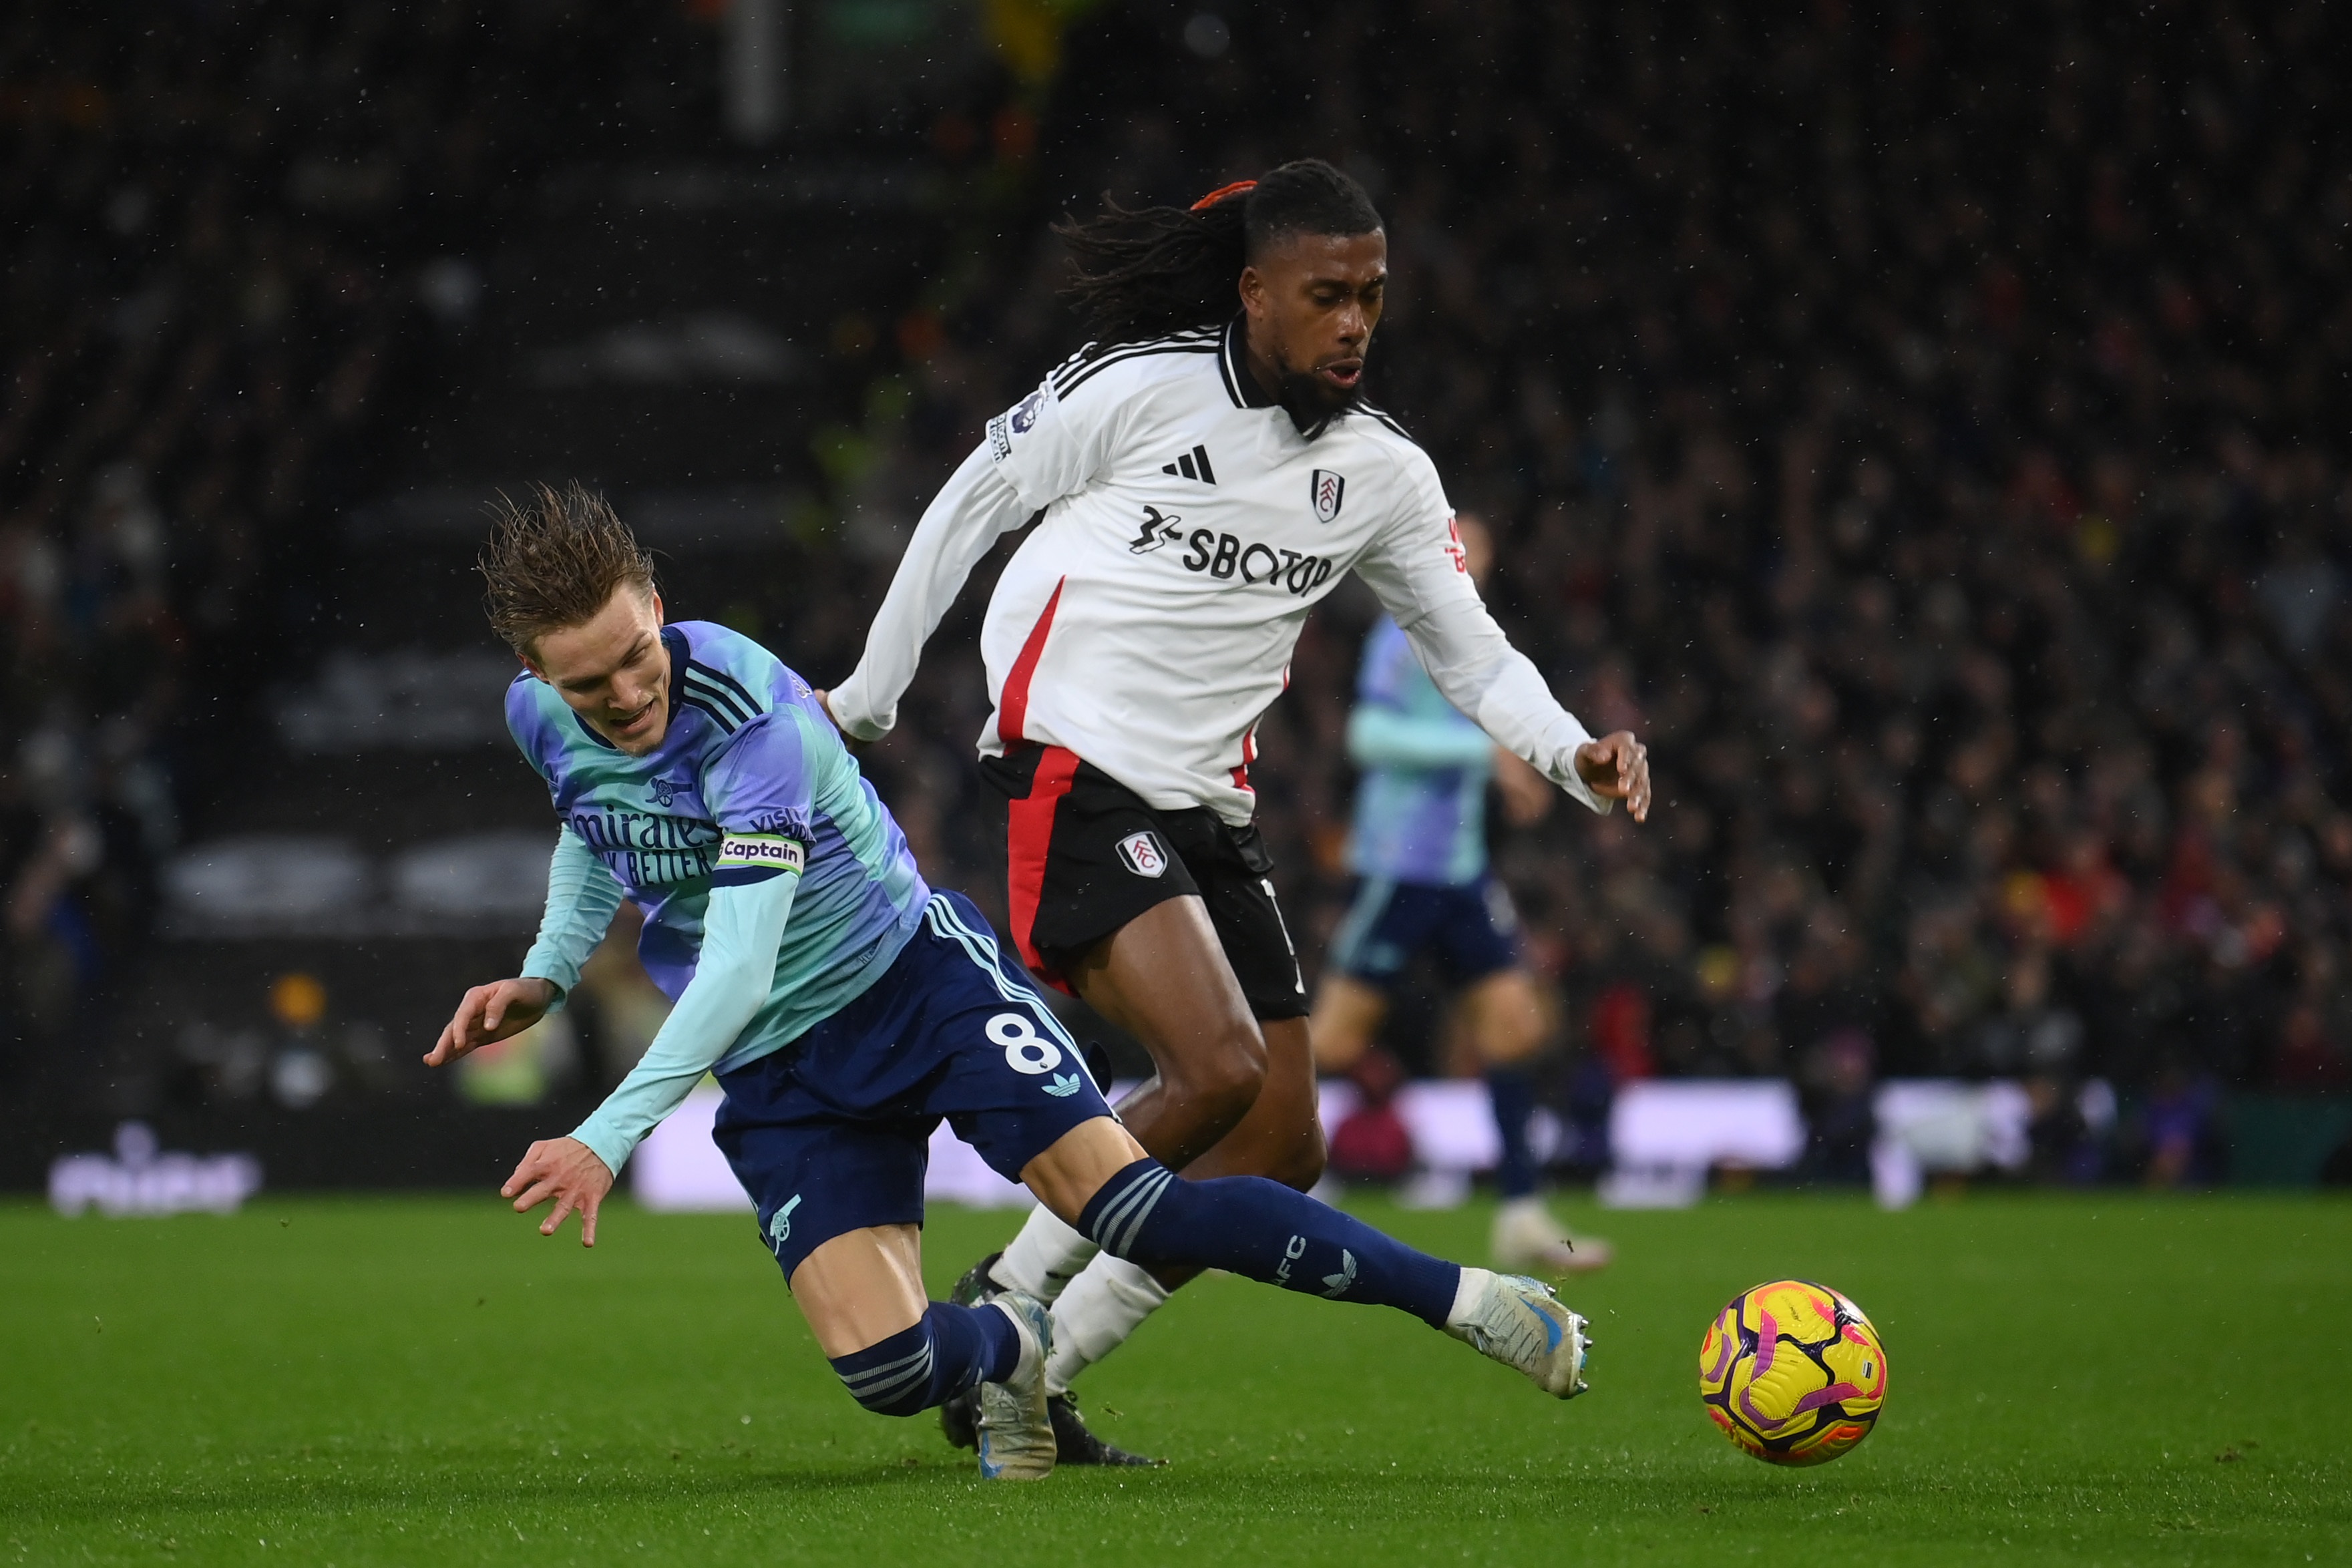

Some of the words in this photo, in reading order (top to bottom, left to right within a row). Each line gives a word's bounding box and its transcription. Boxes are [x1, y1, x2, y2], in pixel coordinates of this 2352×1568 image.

[1320, 477, 1336, 512] FFC
[1183, 528, 1332, 598] SBOTOP
[572, 803, 723, 849] mirates
[626, 848, 713, 886] BETTER
[725, 841, 798, 863] Captain
[1133, 840, 1157, 869] FFC
[985, 1012, 1062, 1074] 8
